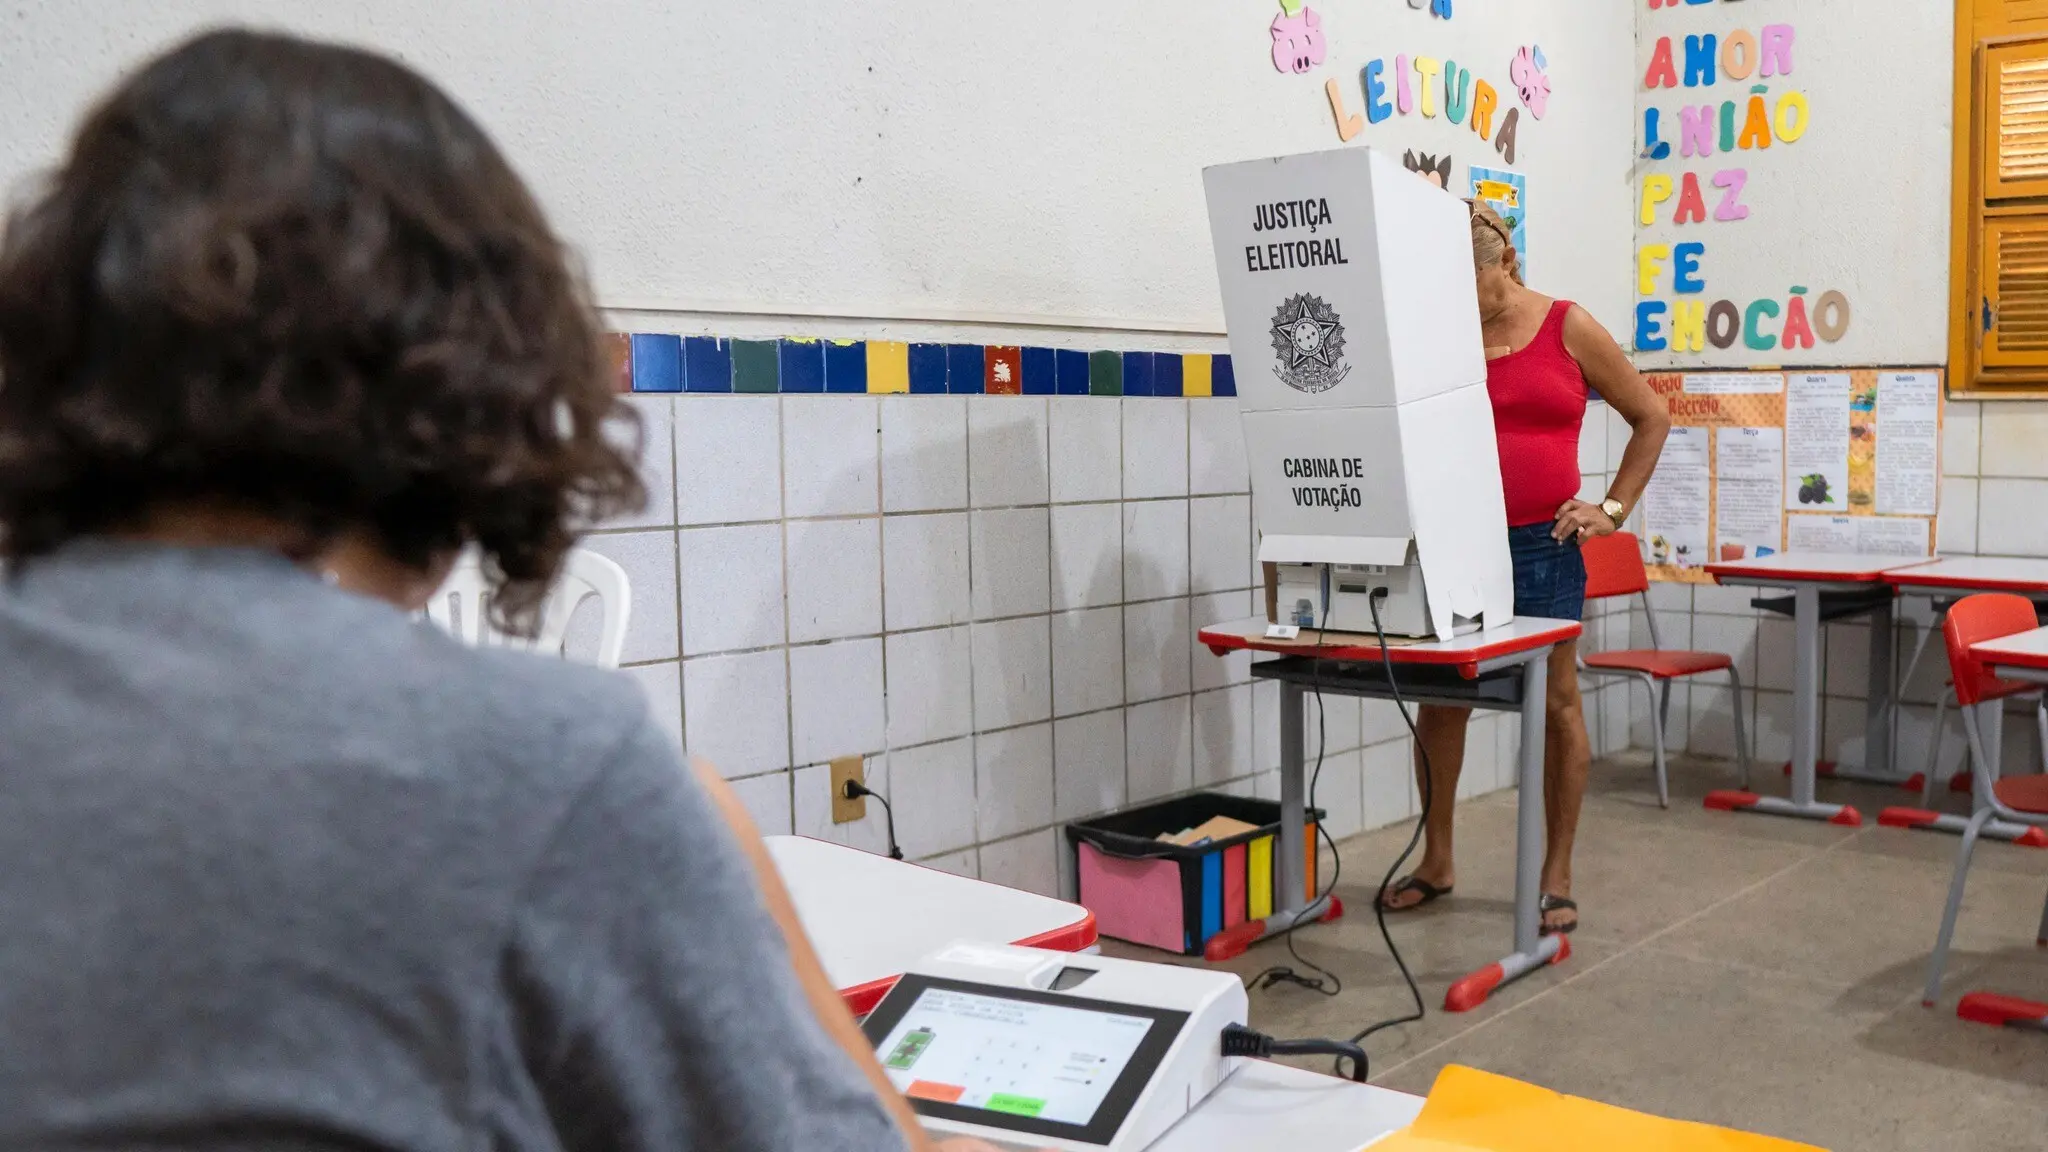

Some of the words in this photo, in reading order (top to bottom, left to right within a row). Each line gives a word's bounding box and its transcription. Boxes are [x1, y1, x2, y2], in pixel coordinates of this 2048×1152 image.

[1645, 24, 1794, 88] AMOR
[1325, 53, 1520, 165] LEITURA
[1253, 198, 1332, 233] JUSTIÇA
[1640, 168, 1749, 226] PAZ
[1245, 238, 1348, 272] ELEITORAL
[1637, 242, 1705, 295] FE
[1283, 458, 1340, 477] CABINA
[1342, 457, 1364, 477] DE
[1292, 483, 1362, 512] VOTAÇÃO
